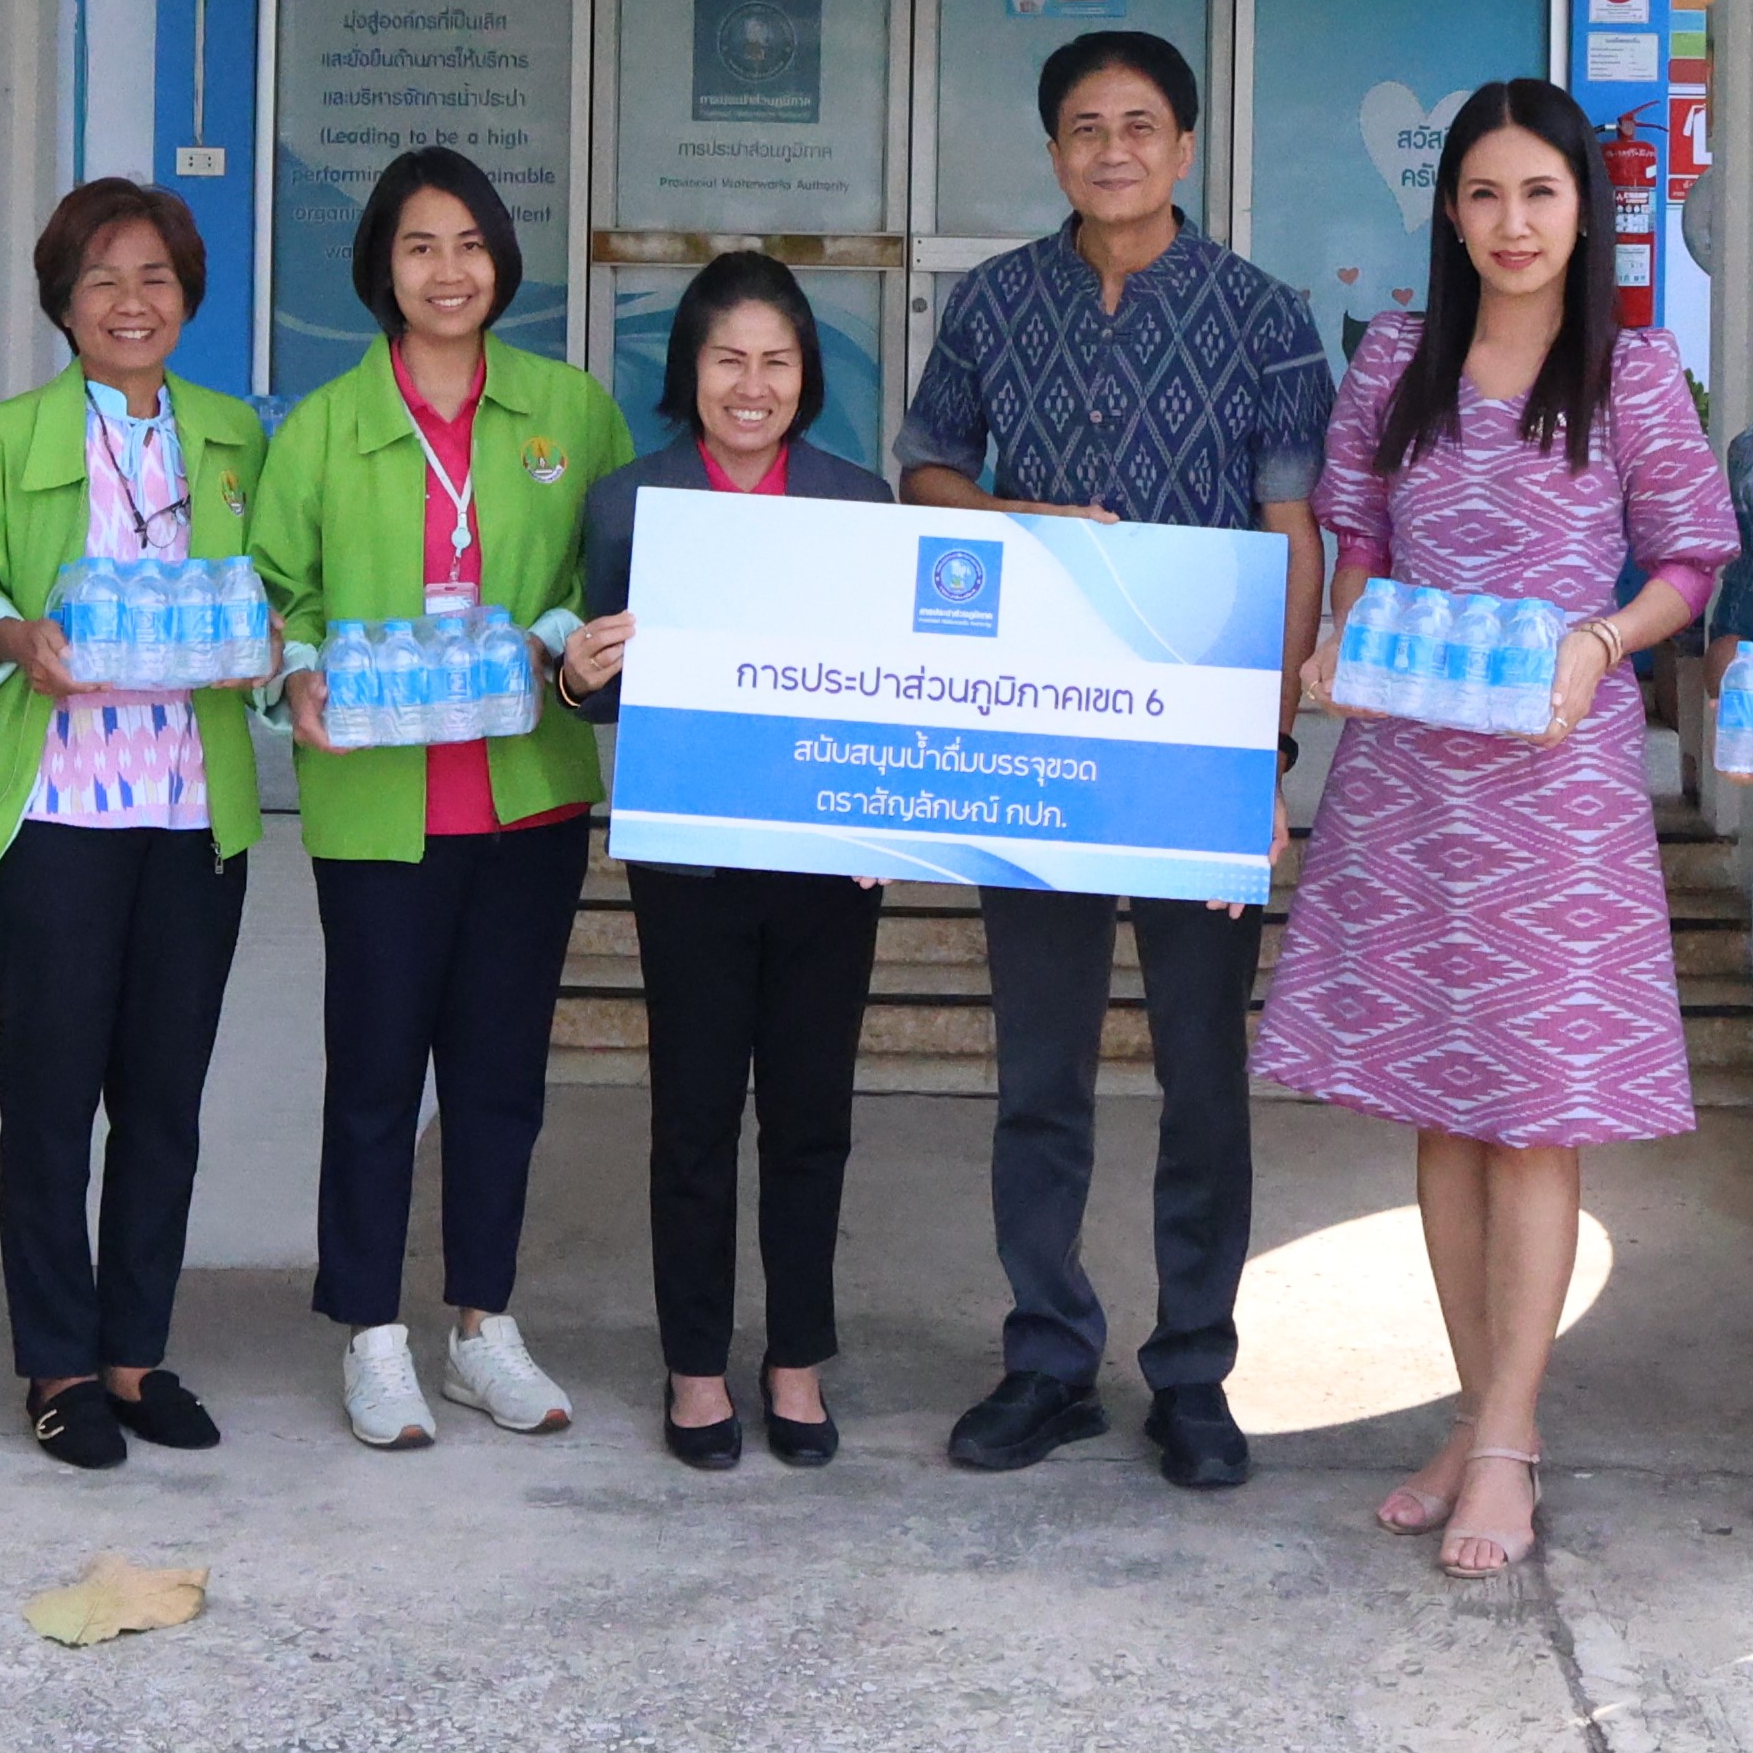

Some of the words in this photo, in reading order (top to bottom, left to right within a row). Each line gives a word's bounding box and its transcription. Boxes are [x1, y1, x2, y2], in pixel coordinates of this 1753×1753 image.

[320, 127, 401, 147] (Leading
[409, 129, 428, 145] to
[435, 129, 457, 145] be
[468, 132, 479, 145] a
[488, 128, 528, 147] high
[1397, 124, 1451, 150] สวัส
[292, 164, 385, 186] performin
[735, 661, 1134, 716] การประปาส่วนภูมิภาคเขต
[1145, 688, 1165, 717] 6
[793, 731, 1098, 787] สนับสนุนน้ำดื่มบรรจุขวด
[816, 786, 1000, 824] ตราสัญลักษณ์
